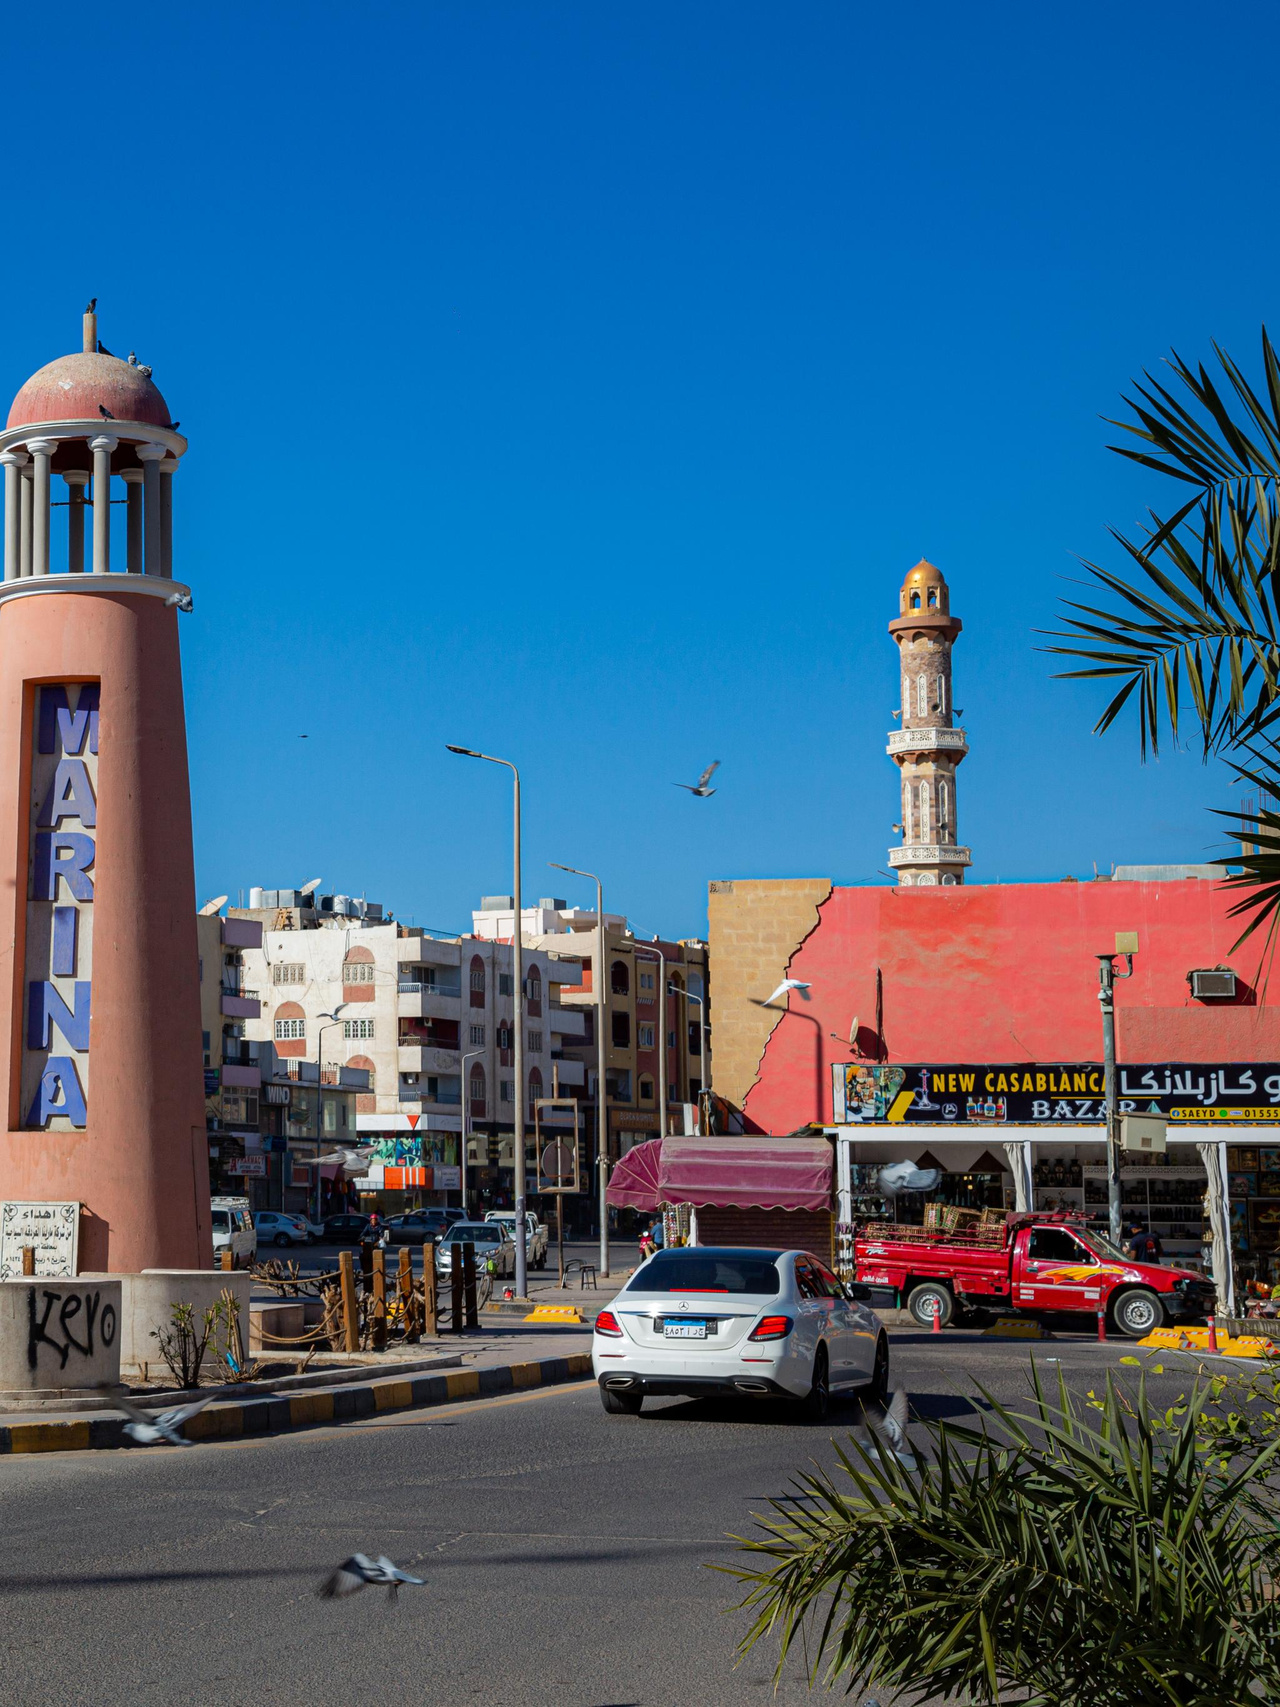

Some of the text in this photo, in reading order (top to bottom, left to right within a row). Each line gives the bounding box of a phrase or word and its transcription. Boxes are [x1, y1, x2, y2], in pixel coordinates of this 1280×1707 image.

[26, 686, 100, 1128] MARINA
[933, 1073, 975, 1092] NEW
[268, 1085, 290, 1104] WIND
[1182, 1109, 1215, 1118] SAEYD
